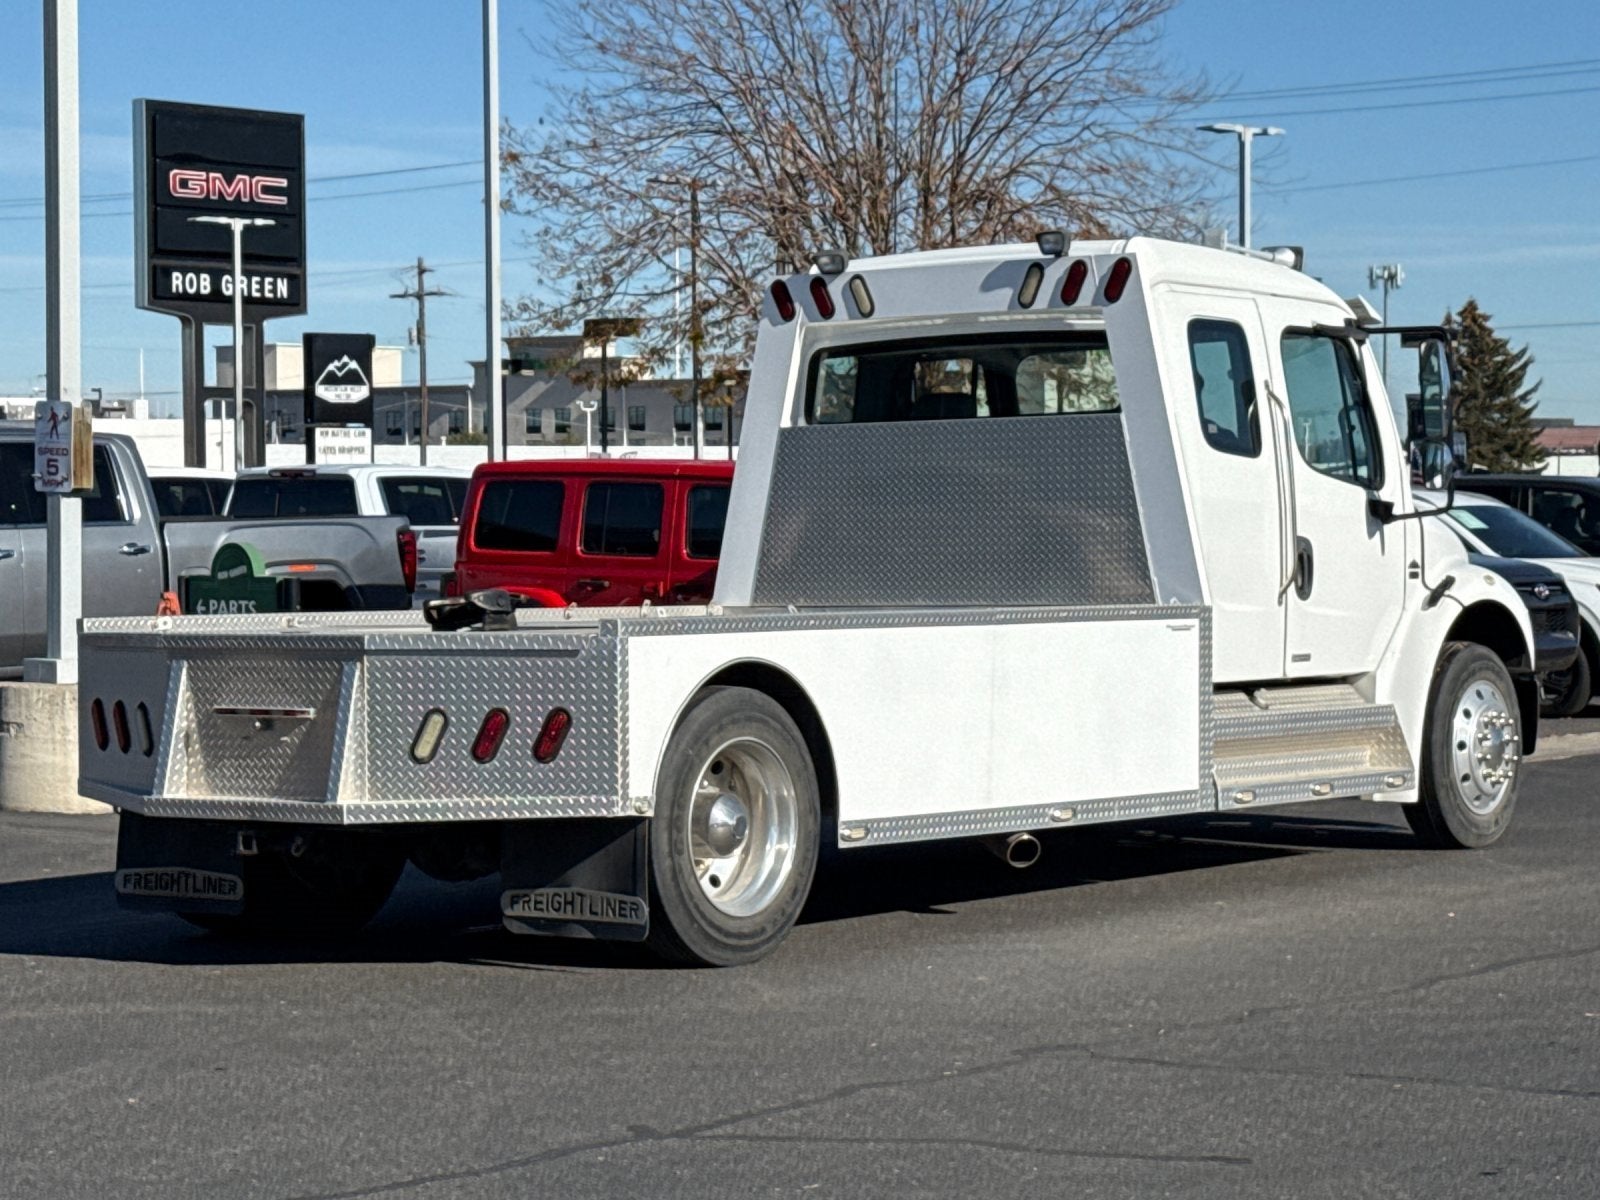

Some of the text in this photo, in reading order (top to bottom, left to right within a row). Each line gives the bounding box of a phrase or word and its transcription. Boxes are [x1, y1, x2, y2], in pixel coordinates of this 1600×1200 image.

[169, 169, 288, 205] GMC
[171, 271, 288, 299] ROB GREEN
[38, 447, 69, 456] SPEED
[46, 458, 59, 476] 5
[209, 600, 257, 614] PARTS
[122, 870, 238, 896] FREIGHTLINER
[510, 892, 640, 919] FREIGHTLINER
